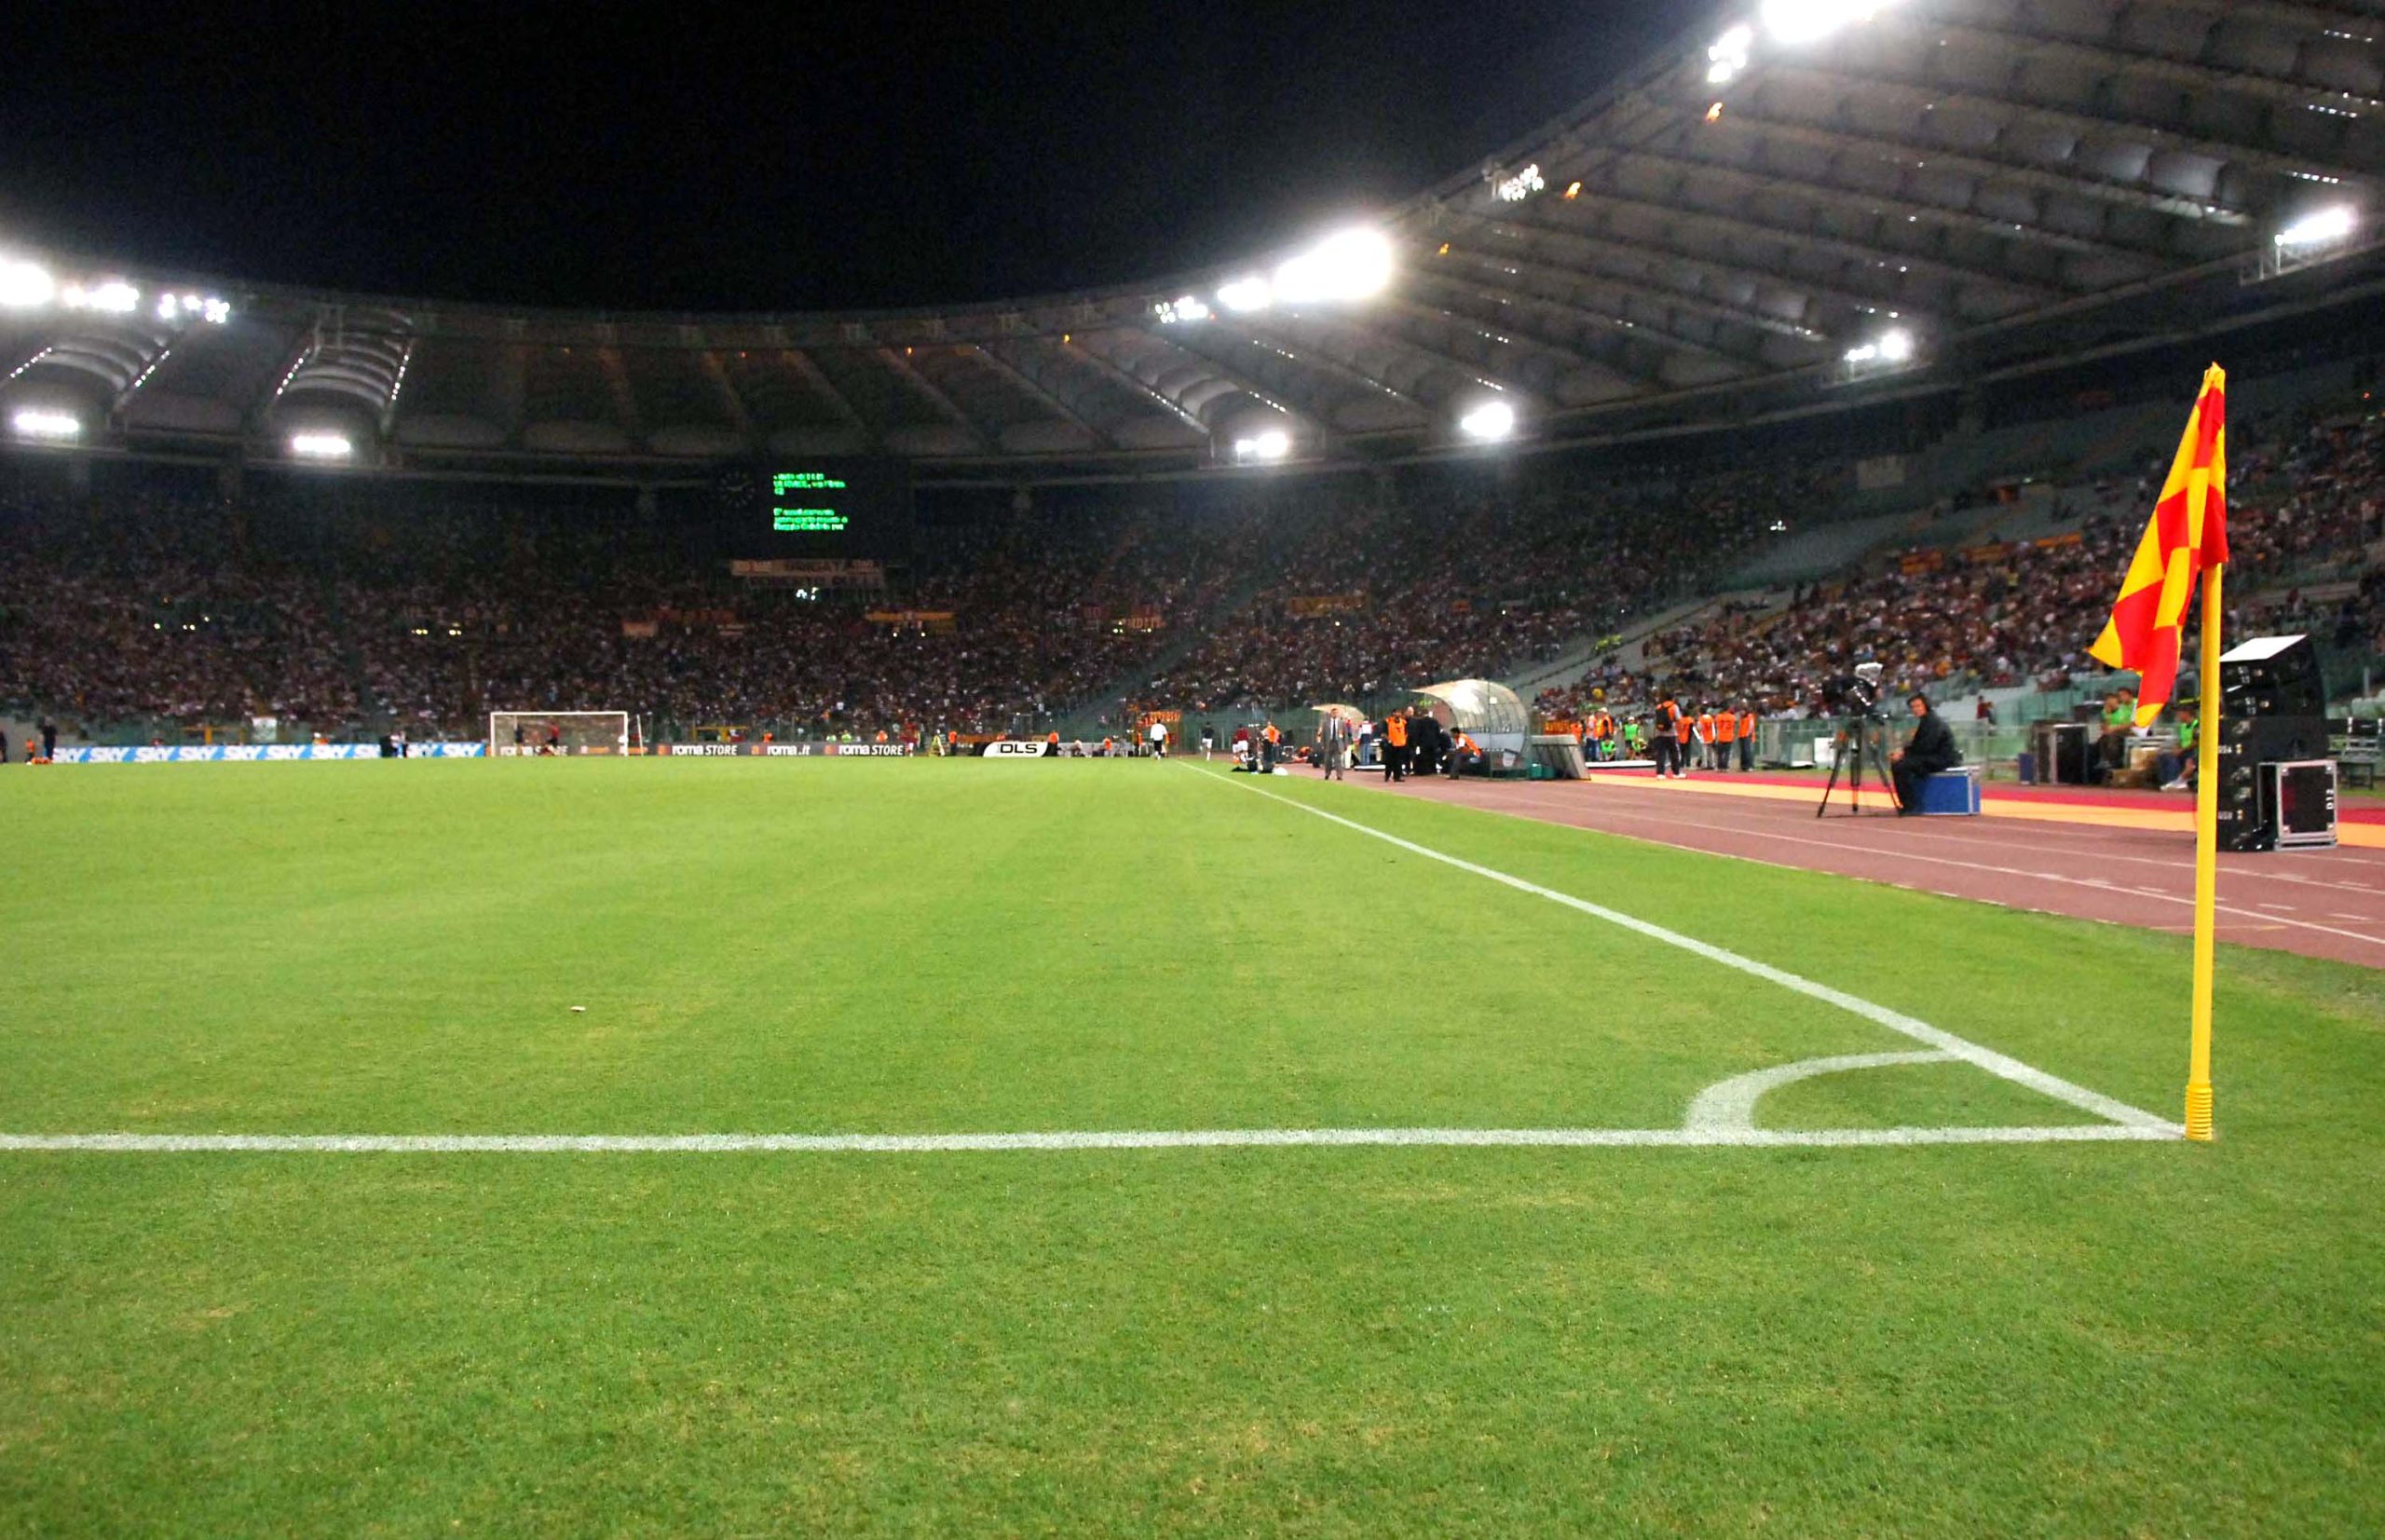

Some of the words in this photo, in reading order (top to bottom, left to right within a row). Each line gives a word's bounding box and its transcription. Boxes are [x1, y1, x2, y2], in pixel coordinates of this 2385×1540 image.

[90, 746, 132, 762] SKY
[136, 745, 175, 761] SKY
[180, 745, 219, 761] SKY
[225, 744, 264, 760] SKY
[268, 744, 307, 759] SKY
[312, 744, 351, 759] SKY
[356, 743, 380, 759] SK
[443, 743, 484, 757] SKY
[672, 744, 703, 756] roma
[705, 744, 738, 756] STORE
[838, 744, 869, 756] roma
[871, 744, 904, 756] STORE
[1000, 743, 1038, 754] DLS
